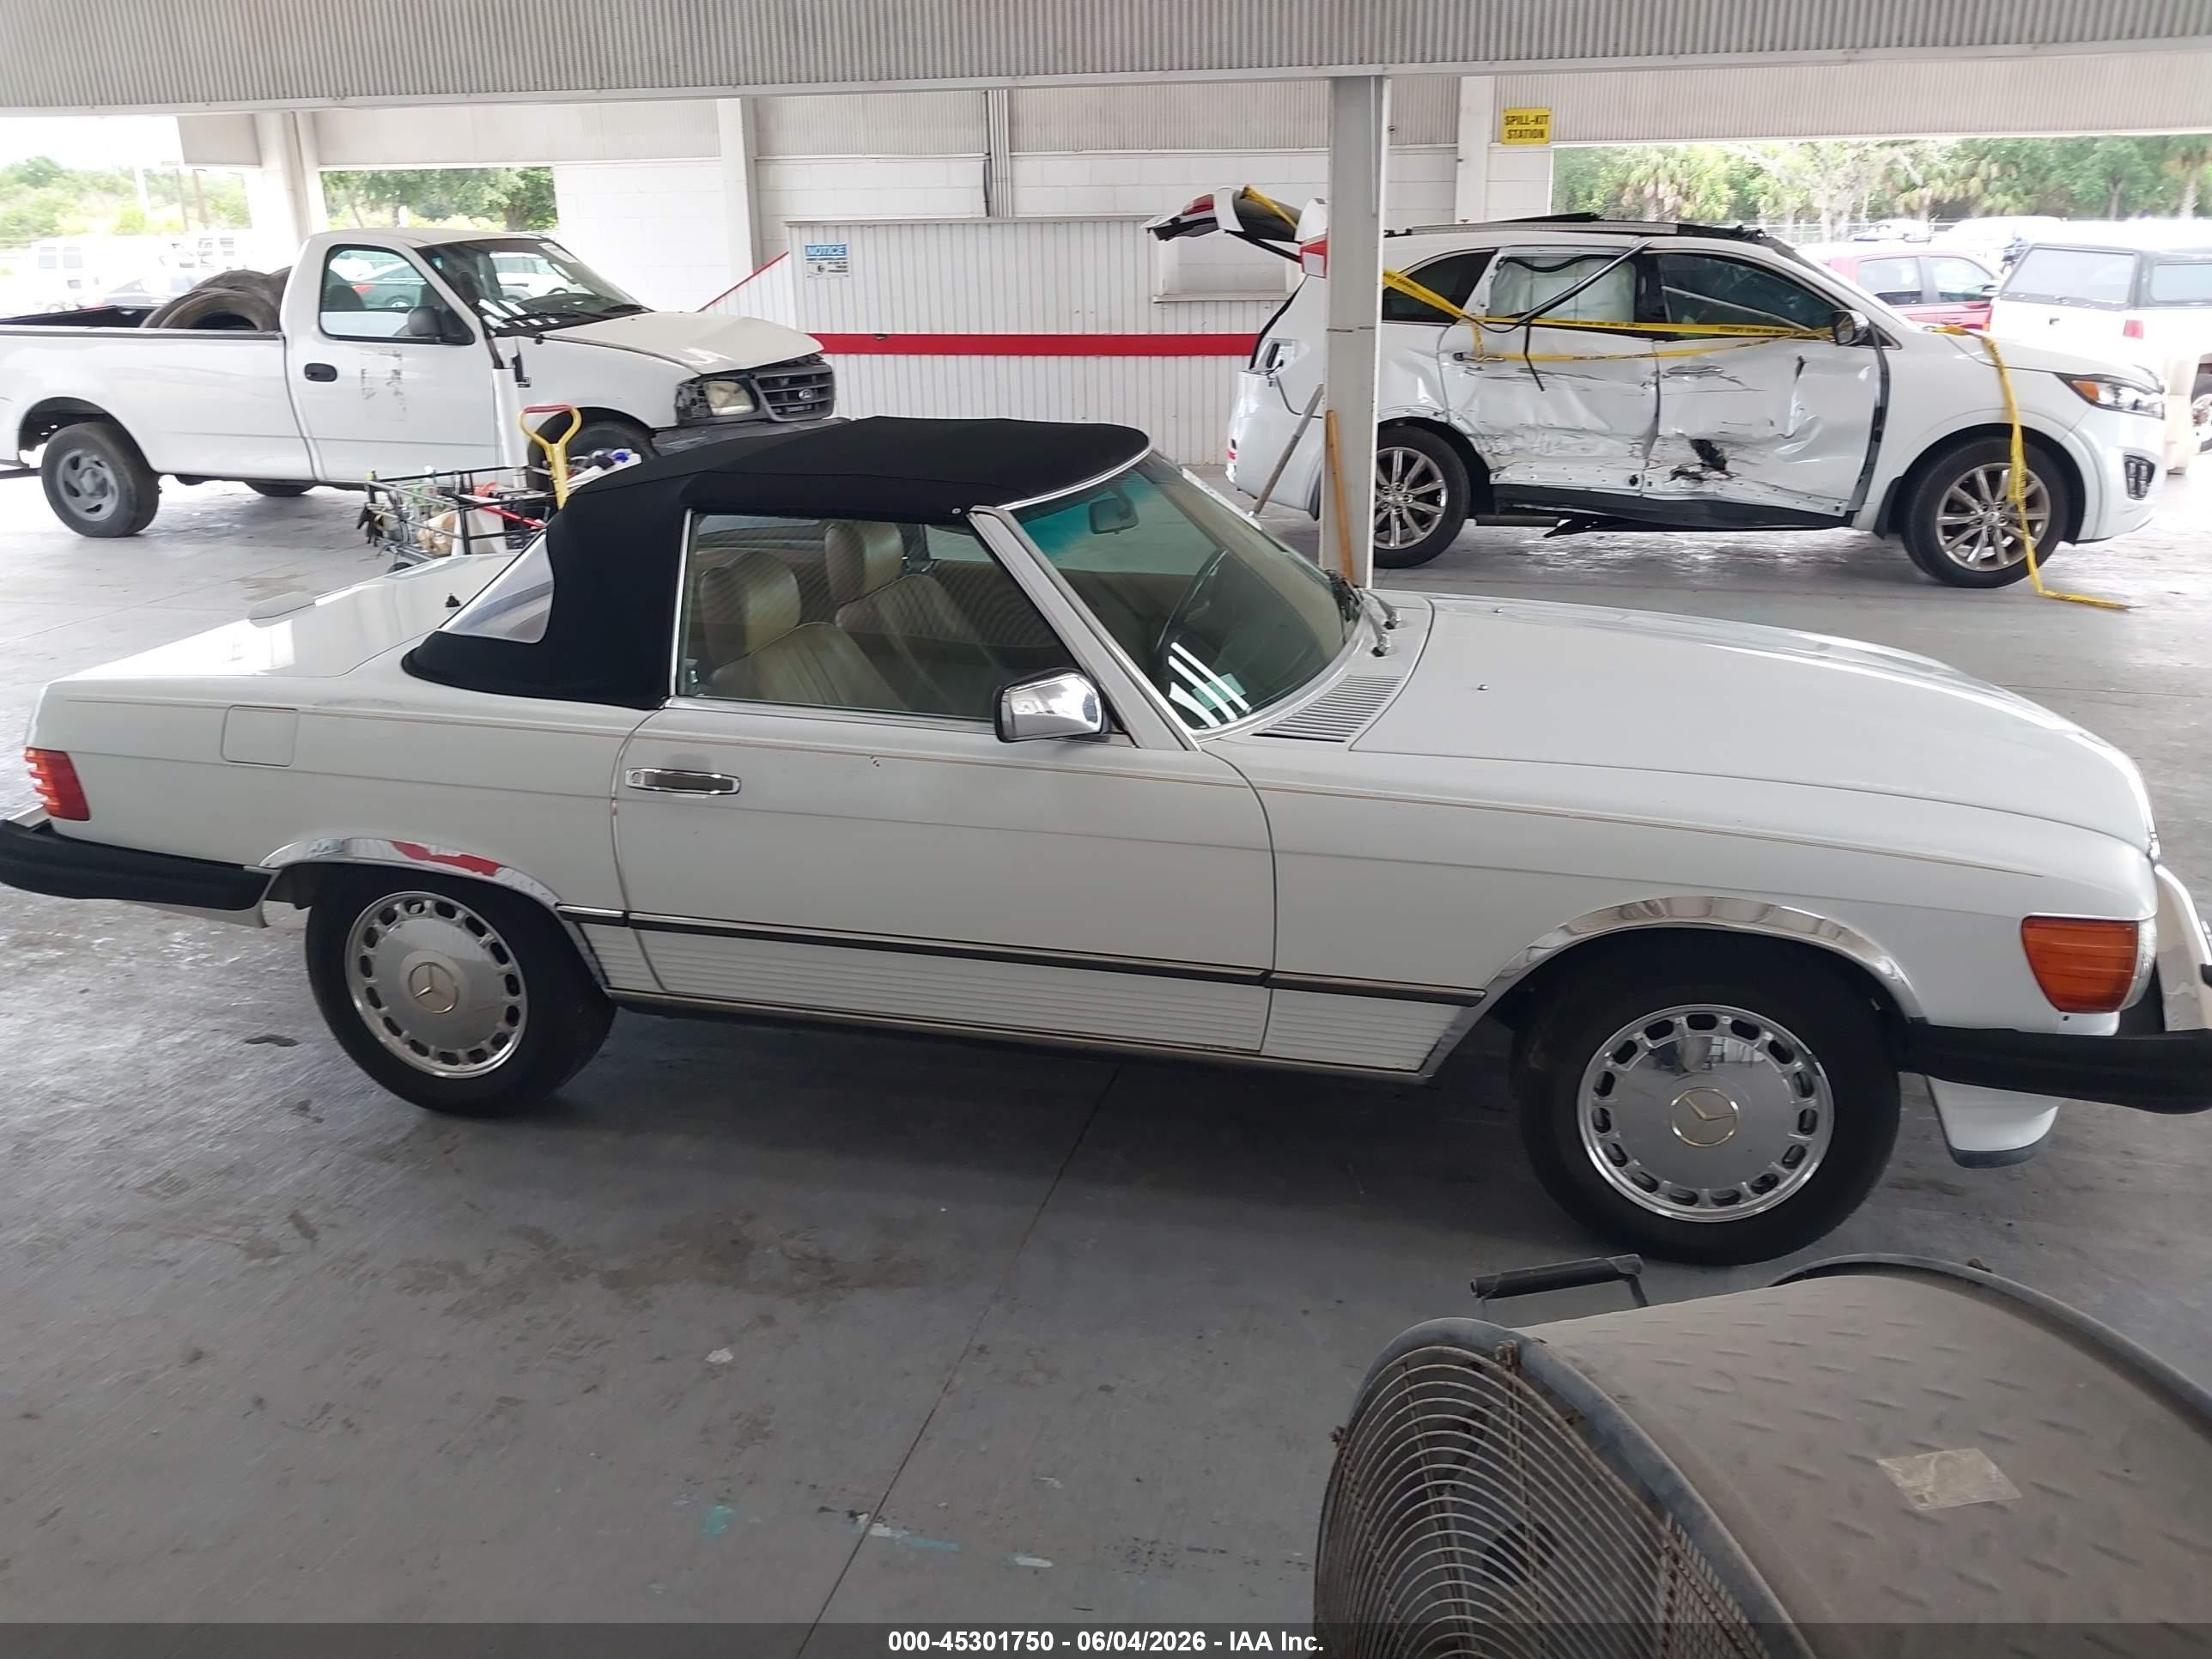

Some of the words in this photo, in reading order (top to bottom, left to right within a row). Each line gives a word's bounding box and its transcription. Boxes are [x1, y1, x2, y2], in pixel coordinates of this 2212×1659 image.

[1504, 114, 1549, 125] SPILL-KIT
[1506, 129, 1546, 139] STATION
[805, 246, 846, 256] NOTICE
